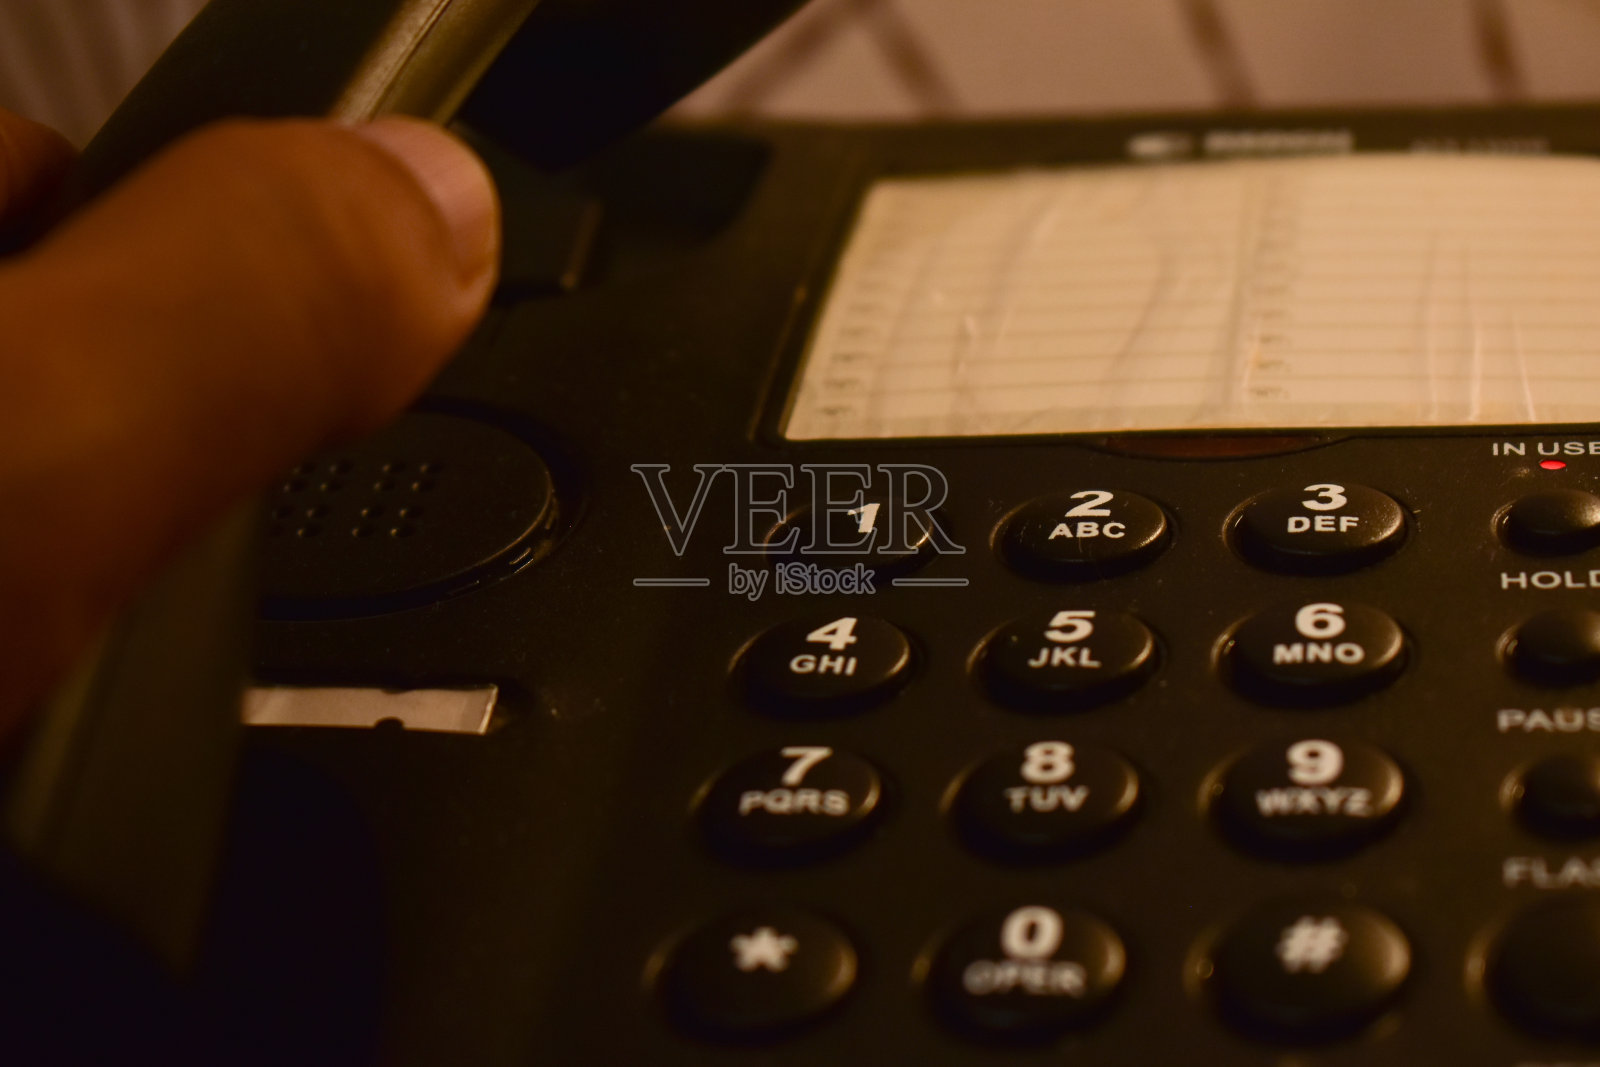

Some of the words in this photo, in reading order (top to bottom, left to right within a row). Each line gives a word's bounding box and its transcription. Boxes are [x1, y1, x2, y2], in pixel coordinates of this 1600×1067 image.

[1492, 442, 1526, 456] IN
[1064, 490, 1114, 517] 2
[1302, 483, 1348, 511] 3
[847, 503, 880, 533] 1
[1048, 522, 1126, 540] ABC
[1287, 516, 1359, 533] DEF
[806, 616, 857, 650] 4
[1043, 610, 1095, 643] 5
[1295, 602, 1346, 639] 6
[789, 654, 857, 676] GHI
[1027, 646, 1102, 668] JKL
[1272, 642, 1365, 665] MNO
[781, 746, 833, 786] 7
[1020, 740, 1076, 783] 8
[1286, 739, 1344, 785] 9
[738, 788, 849, 816] PQRS
[1004, 785, 1090, 813] TUV
[1255, 787, 1374, 817] WXYZ
[1502, 857, 1600, 889] FLA
